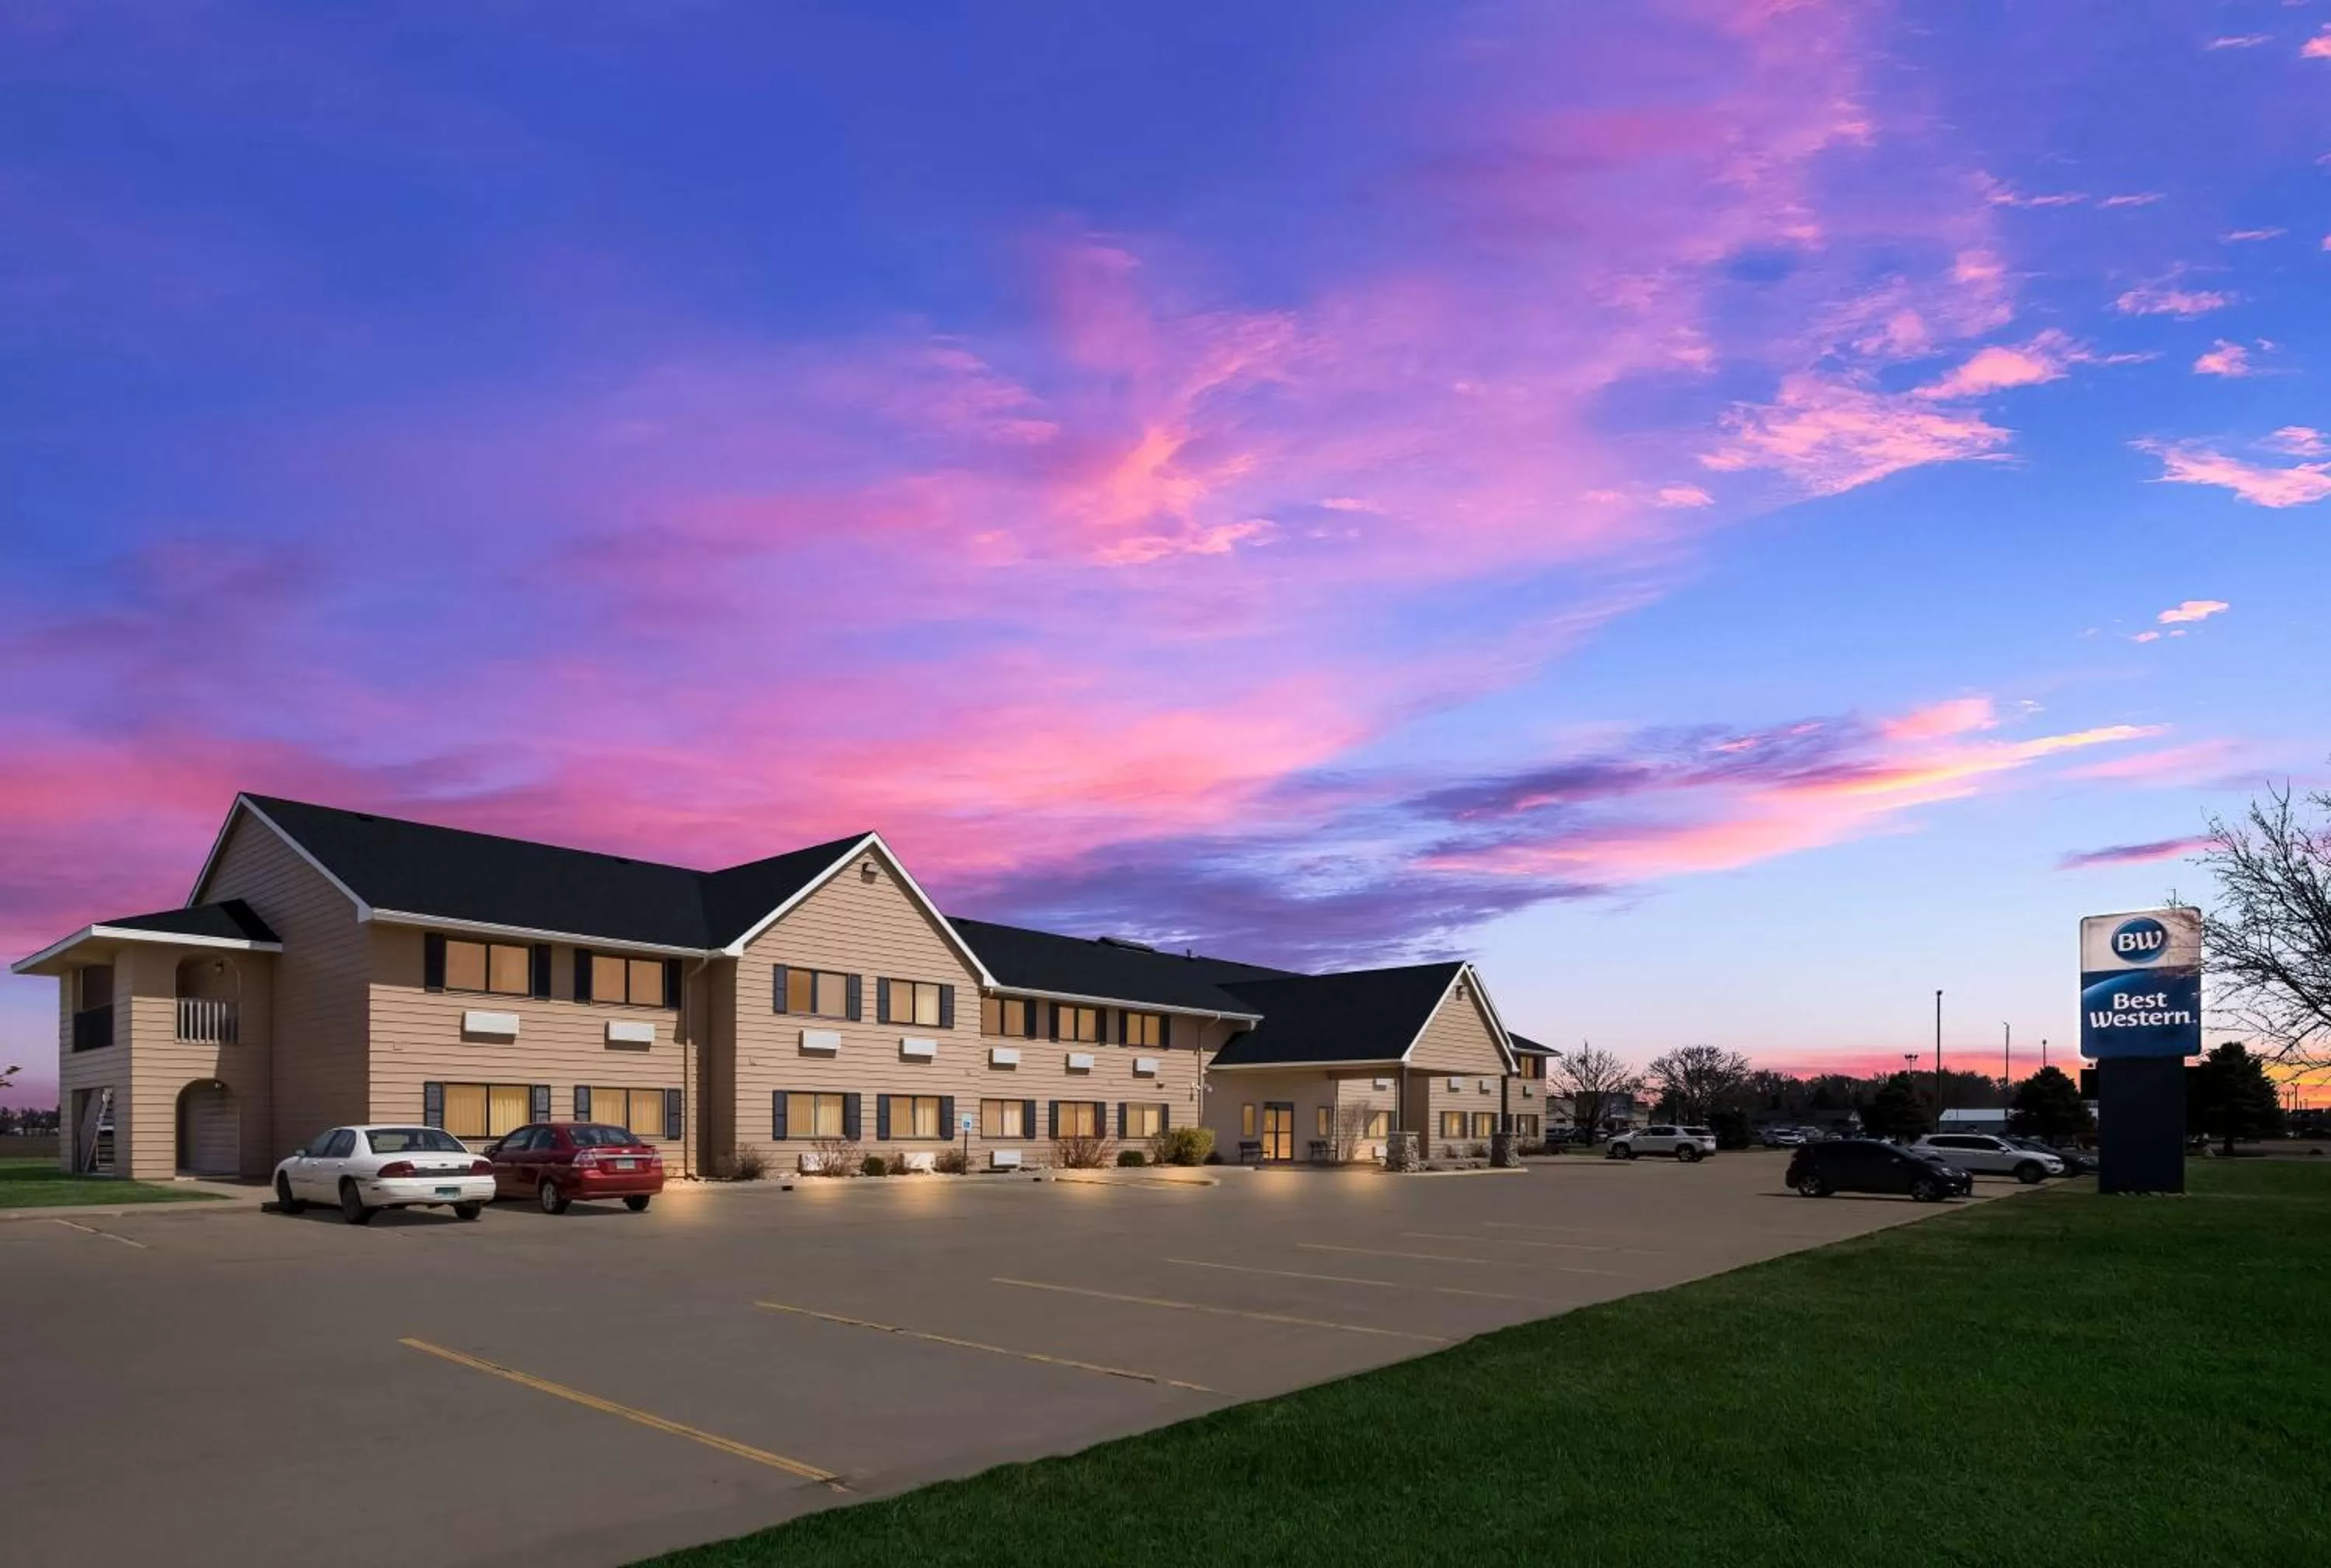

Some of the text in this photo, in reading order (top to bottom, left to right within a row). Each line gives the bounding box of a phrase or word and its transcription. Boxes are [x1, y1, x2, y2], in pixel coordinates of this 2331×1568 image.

[2117, 931, 2162, 952] BW
[2113, 992, 2167, 1009] Best
[2089, 1010, 2191, 1028] Western
